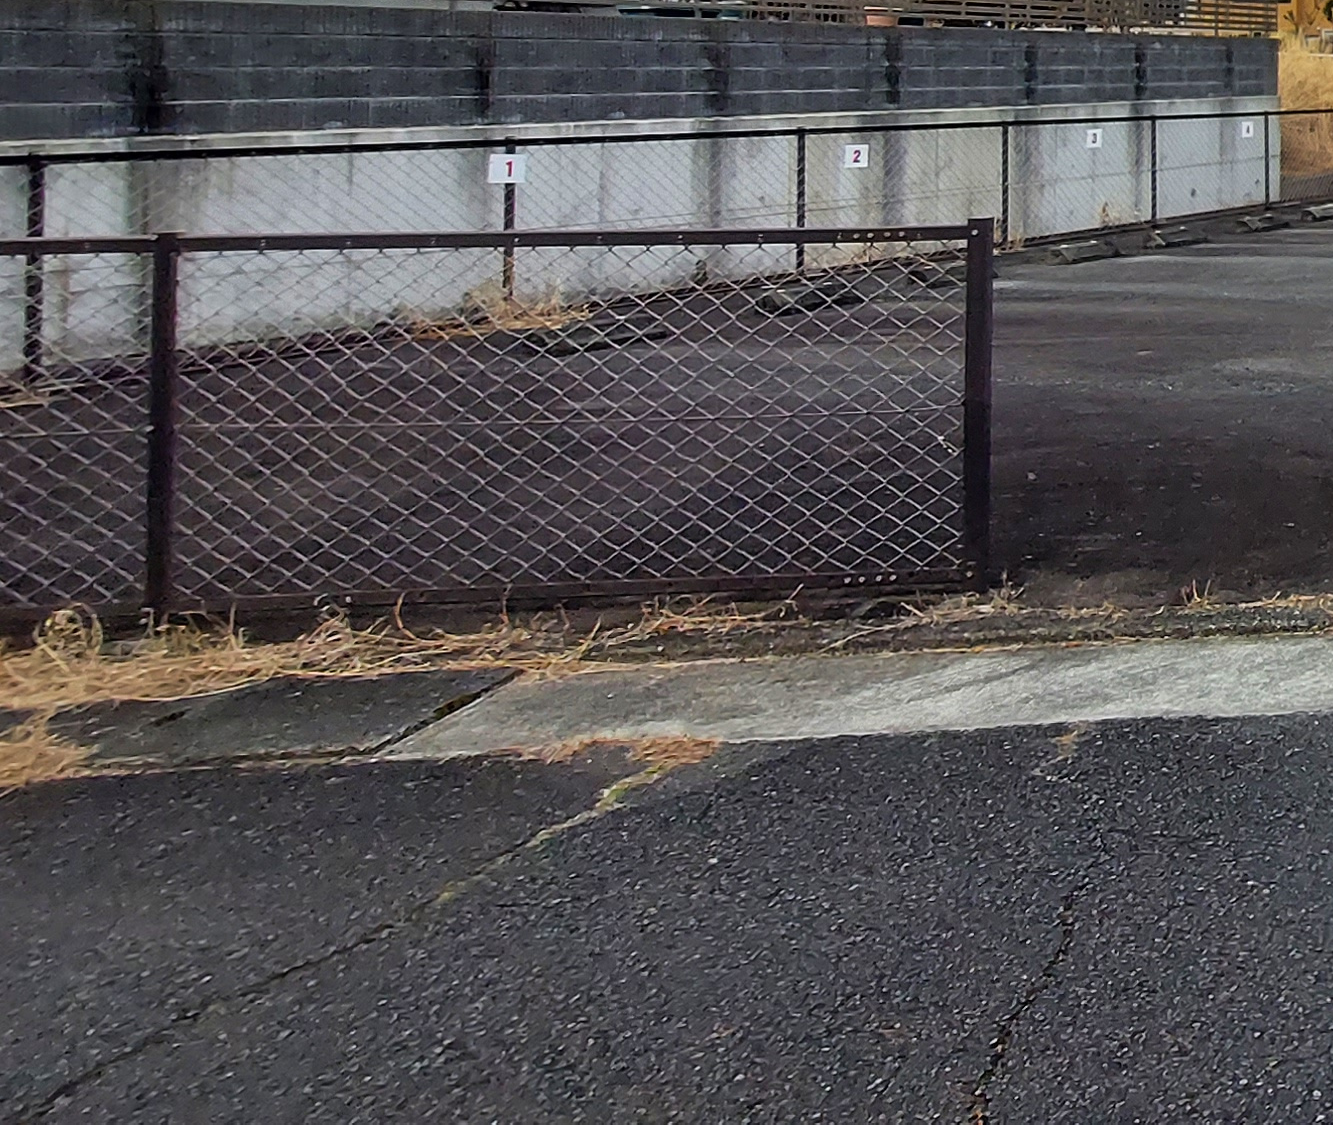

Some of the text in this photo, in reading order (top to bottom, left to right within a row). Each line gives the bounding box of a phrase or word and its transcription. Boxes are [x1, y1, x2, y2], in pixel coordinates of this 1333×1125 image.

[1091, 132, 1098, 144] 3
[852, 149, 862, 163] 2
[505, 160, 513, 177] 1
